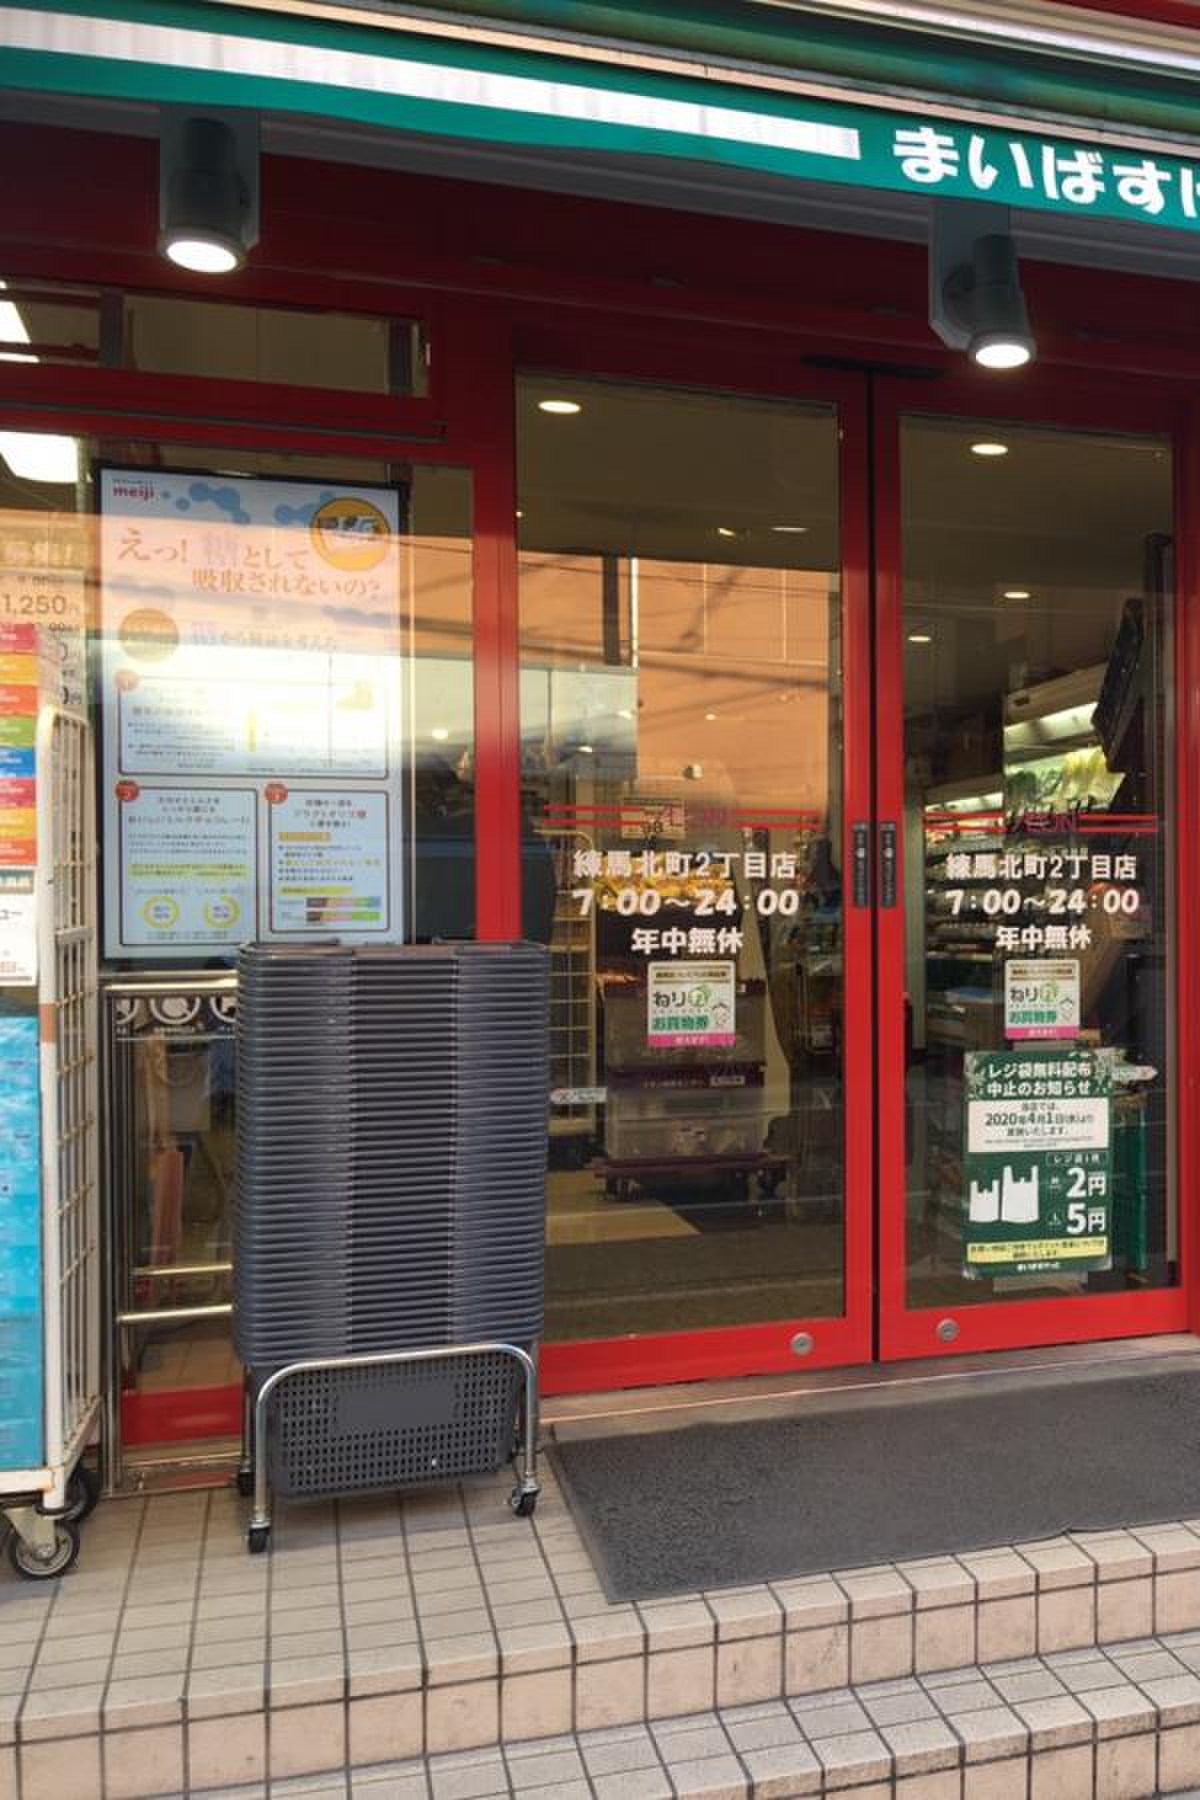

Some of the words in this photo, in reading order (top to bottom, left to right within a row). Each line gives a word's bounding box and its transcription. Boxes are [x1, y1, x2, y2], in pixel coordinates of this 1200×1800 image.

[113, 485, 154, 501] meiji
[573, 850, 798, 879] 練馬北町2丁目店
[945, 853, 1137, 880] 練馬北町2丁目店
[631, 927, 743, 955] 年中無休
[996, 925, 1092, 951] 年中無休
[988, 1061, 1091, 1079] レジ袋無料配布
[987, 1079, 1091, 1098] 中止のお知らせ
[1065, 1167, 1106, 1199] 2円
[1065, 1202, 1106, 1235] 5円
